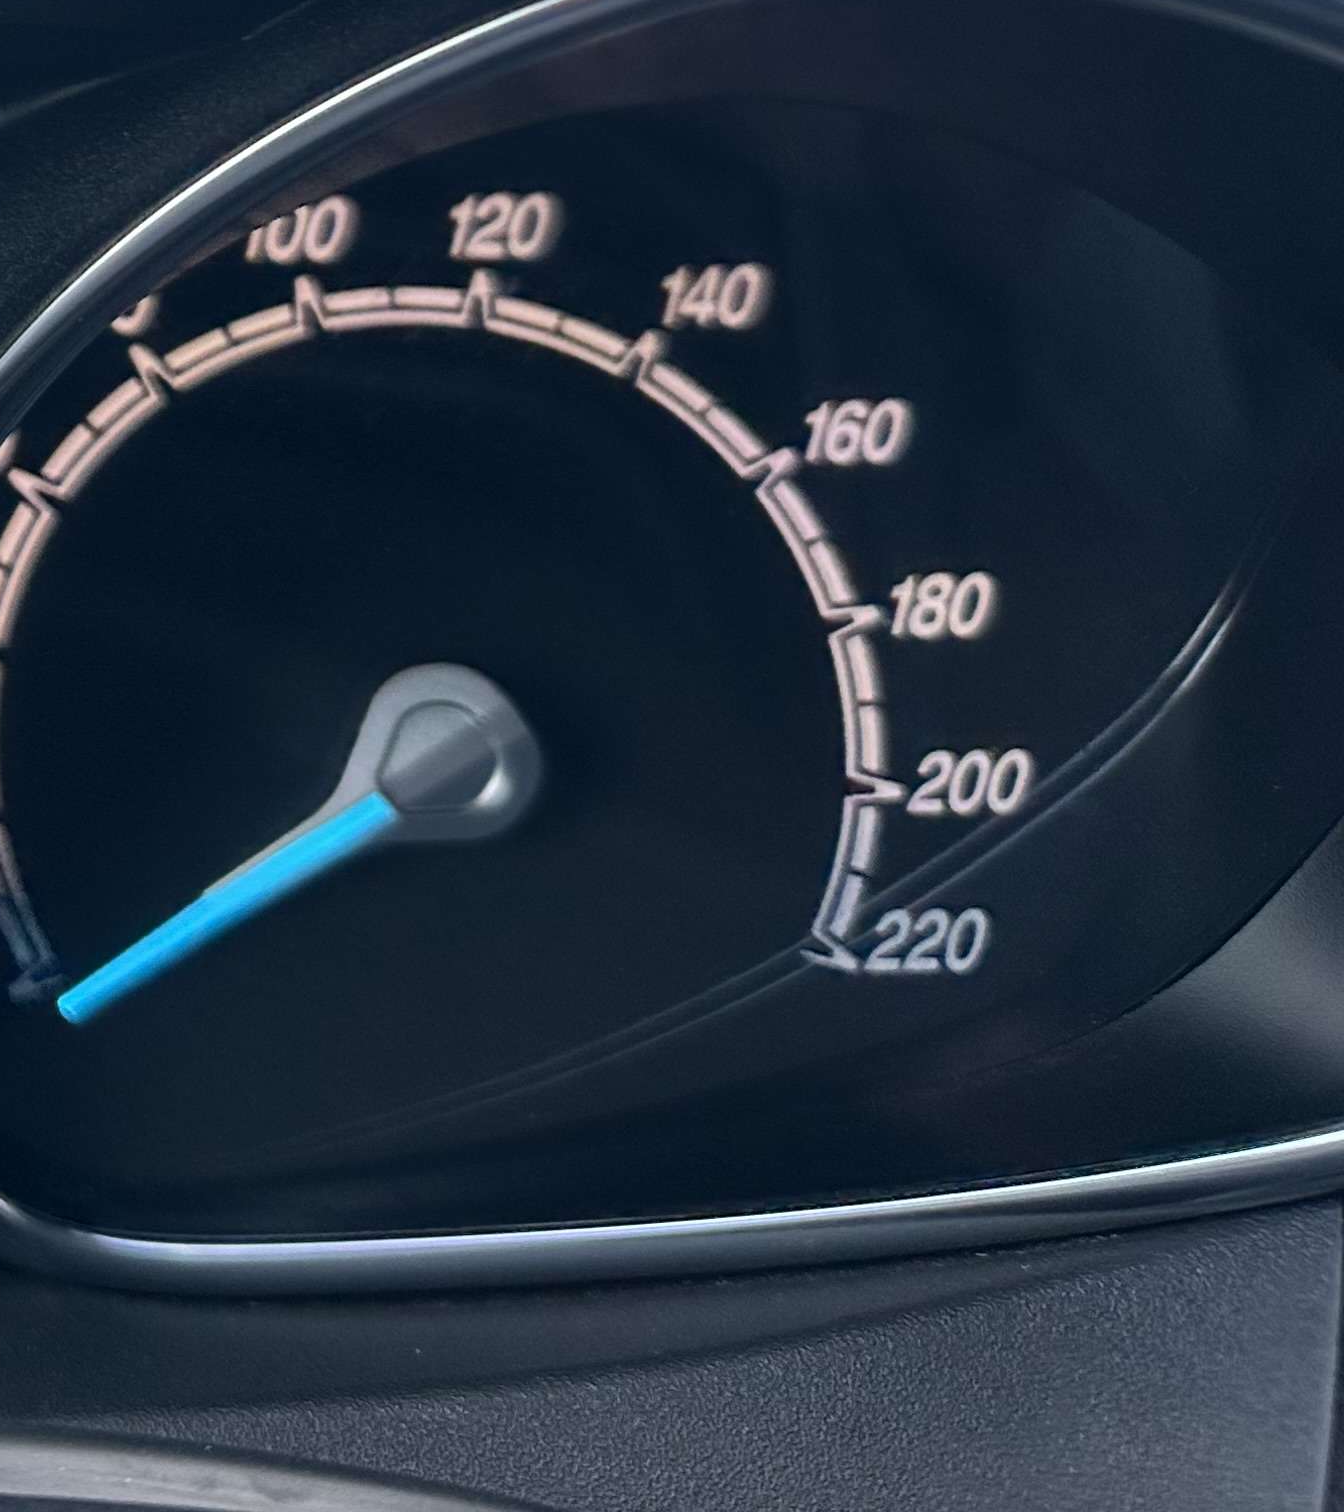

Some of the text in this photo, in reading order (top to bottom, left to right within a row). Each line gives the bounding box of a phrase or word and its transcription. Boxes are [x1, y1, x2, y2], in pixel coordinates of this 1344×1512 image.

[448, 191, 559, 263] 120
[660, 261, 771, 330] 140
[805, 396, 914, 465] 160
[889, 570, 1000, 640] 180
[910, 746, 1036, 817] 200
[864, 901, 993, 974] 220
